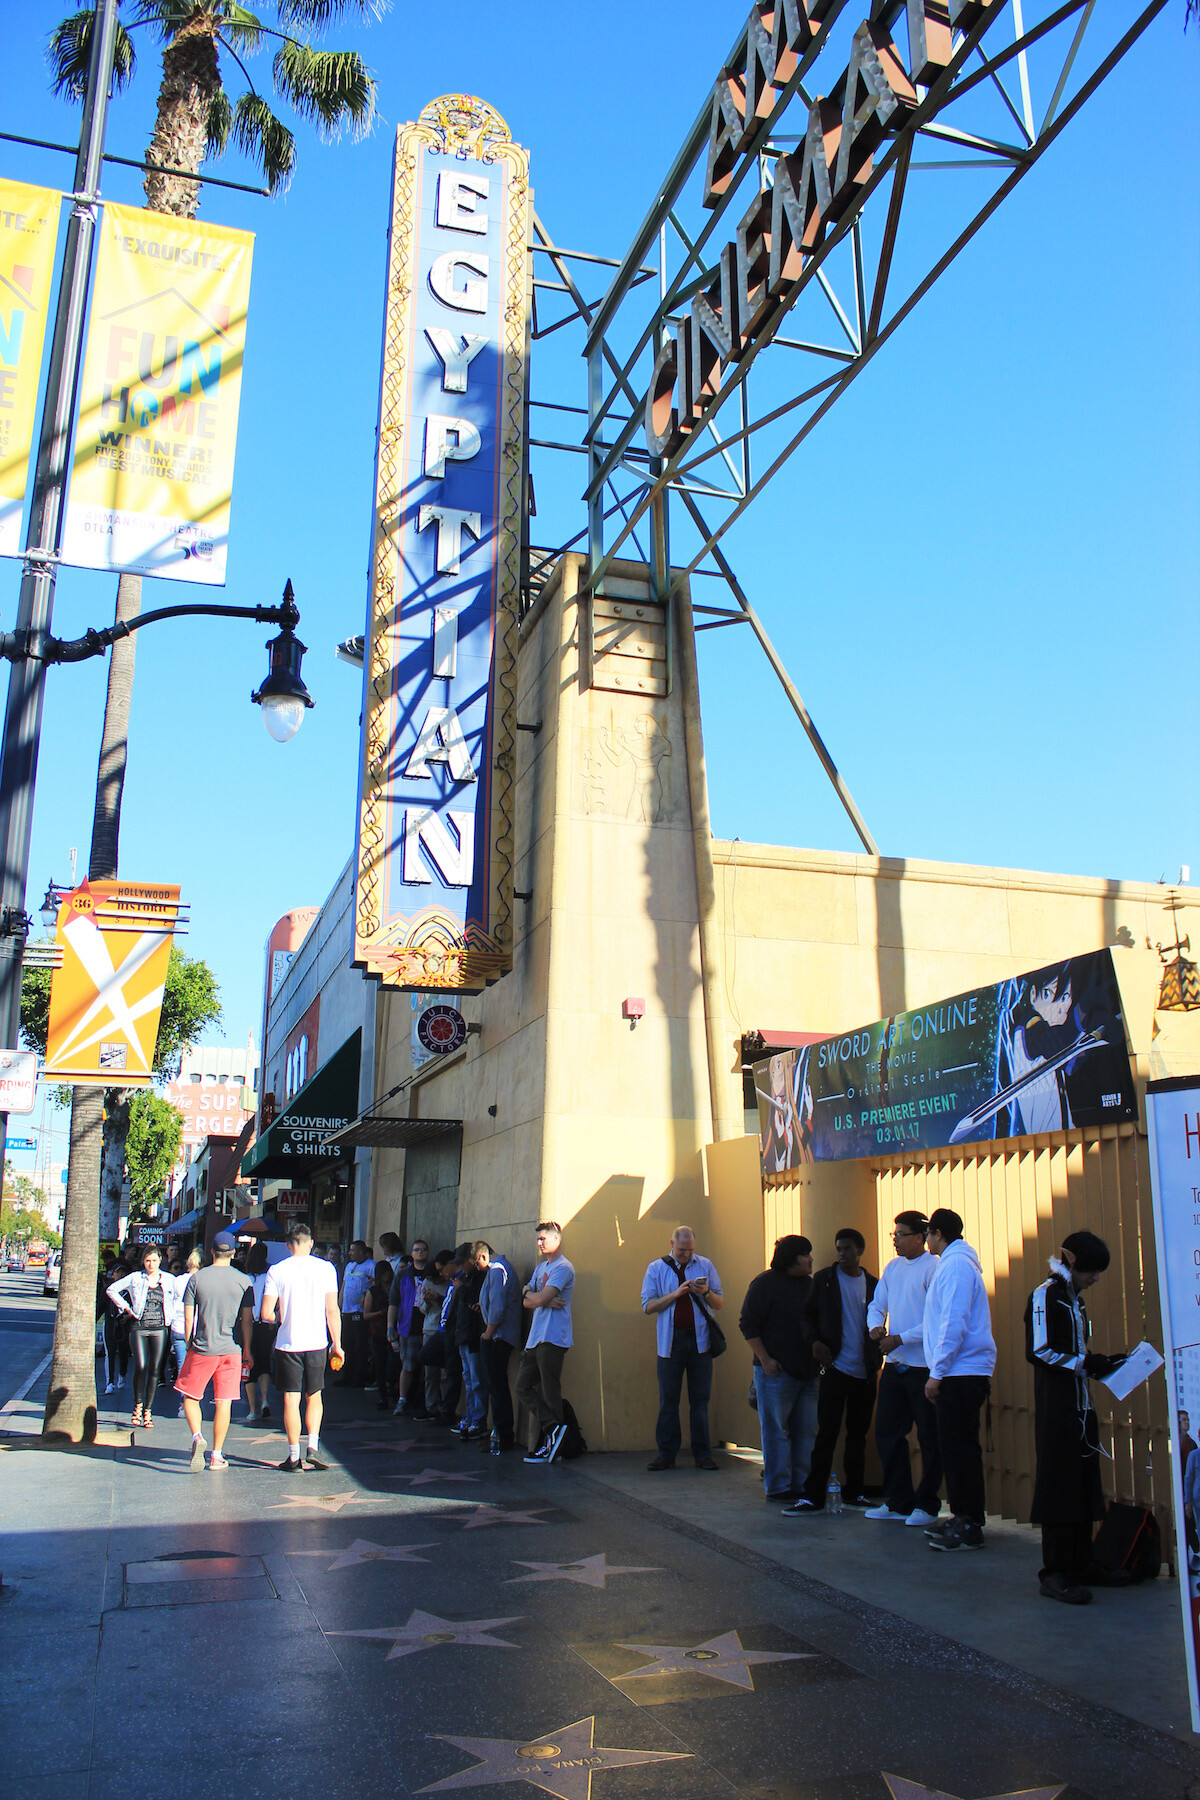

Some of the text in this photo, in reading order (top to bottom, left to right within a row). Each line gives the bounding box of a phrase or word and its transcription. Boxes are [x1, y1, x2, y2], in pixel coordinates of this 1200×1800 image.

[105, 325, 223, 398] FUN
[101, 382, 217, 440] HOME
[98, 429, 213, 464] WINNER!
[95, 445, 212, 474] FIVE 2015 TONY AWARDS
[98, 456, 138, 473] BEST
[141, 464, 212, 486] MUSICAL
[84, 522, 115, 536] DTLA
[163, 522, 214, 540] THEATRE
[402, 169, 491, 887] EGYPTIAN
[118, 887, 170, 899] HOLLYWOOD
[74, 898, 91, 909] 36
[117, 902, 168, 913] HISTORIC
[421, 1006, 464, 1025] JUICY
[420, 1031, 464, 1052] FACTORY
[818, 997, 978, 1069] SWORD ART ONLINE
[866, 1051, 916, 1076] THE MOVIE
[847, 1067, 940, 1099] Ordinal Scale
[199, 1092, 244, 1112] SUP
[834, 1093, 957, 1131] U.S. PREMIERE EVENT
[282, 1115, 349, 1128] SOUVENIRS
[877, 1121, 920, 1144] 03.01.17
[282, 1143, 341, 1157] & SHIRTS
[281, 1191, 308, 1204] ATM
[138, 1235, 163, 1244] SOON
[139, 1227, 164, 1236] COMING
[550, 1756, 603, 1769] DIANA
